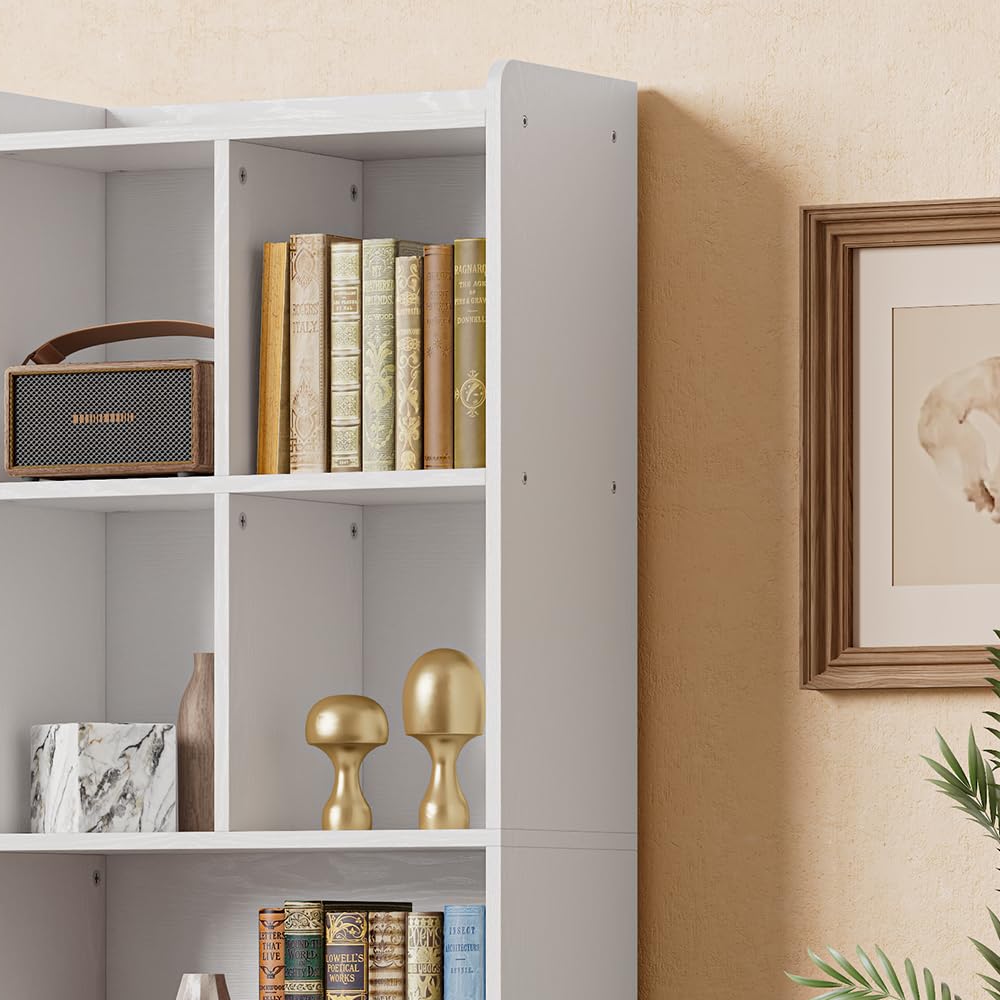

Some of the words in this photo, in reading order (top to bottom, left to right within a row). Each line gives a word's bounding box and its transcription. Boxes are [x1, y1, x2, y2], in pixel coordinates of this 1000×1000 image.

[455, 264, 486, 274] RAGNARO
[456, 316, 486, 325] DONNELL
[262, 942, 282, 950] THAT
[262, 952, 281, 961] LIVE
[325, 953, 364, 963] LOWELL'S
[327, 964, 360, 973] POETICAL
[329, 974, 356, 985] WORKS
